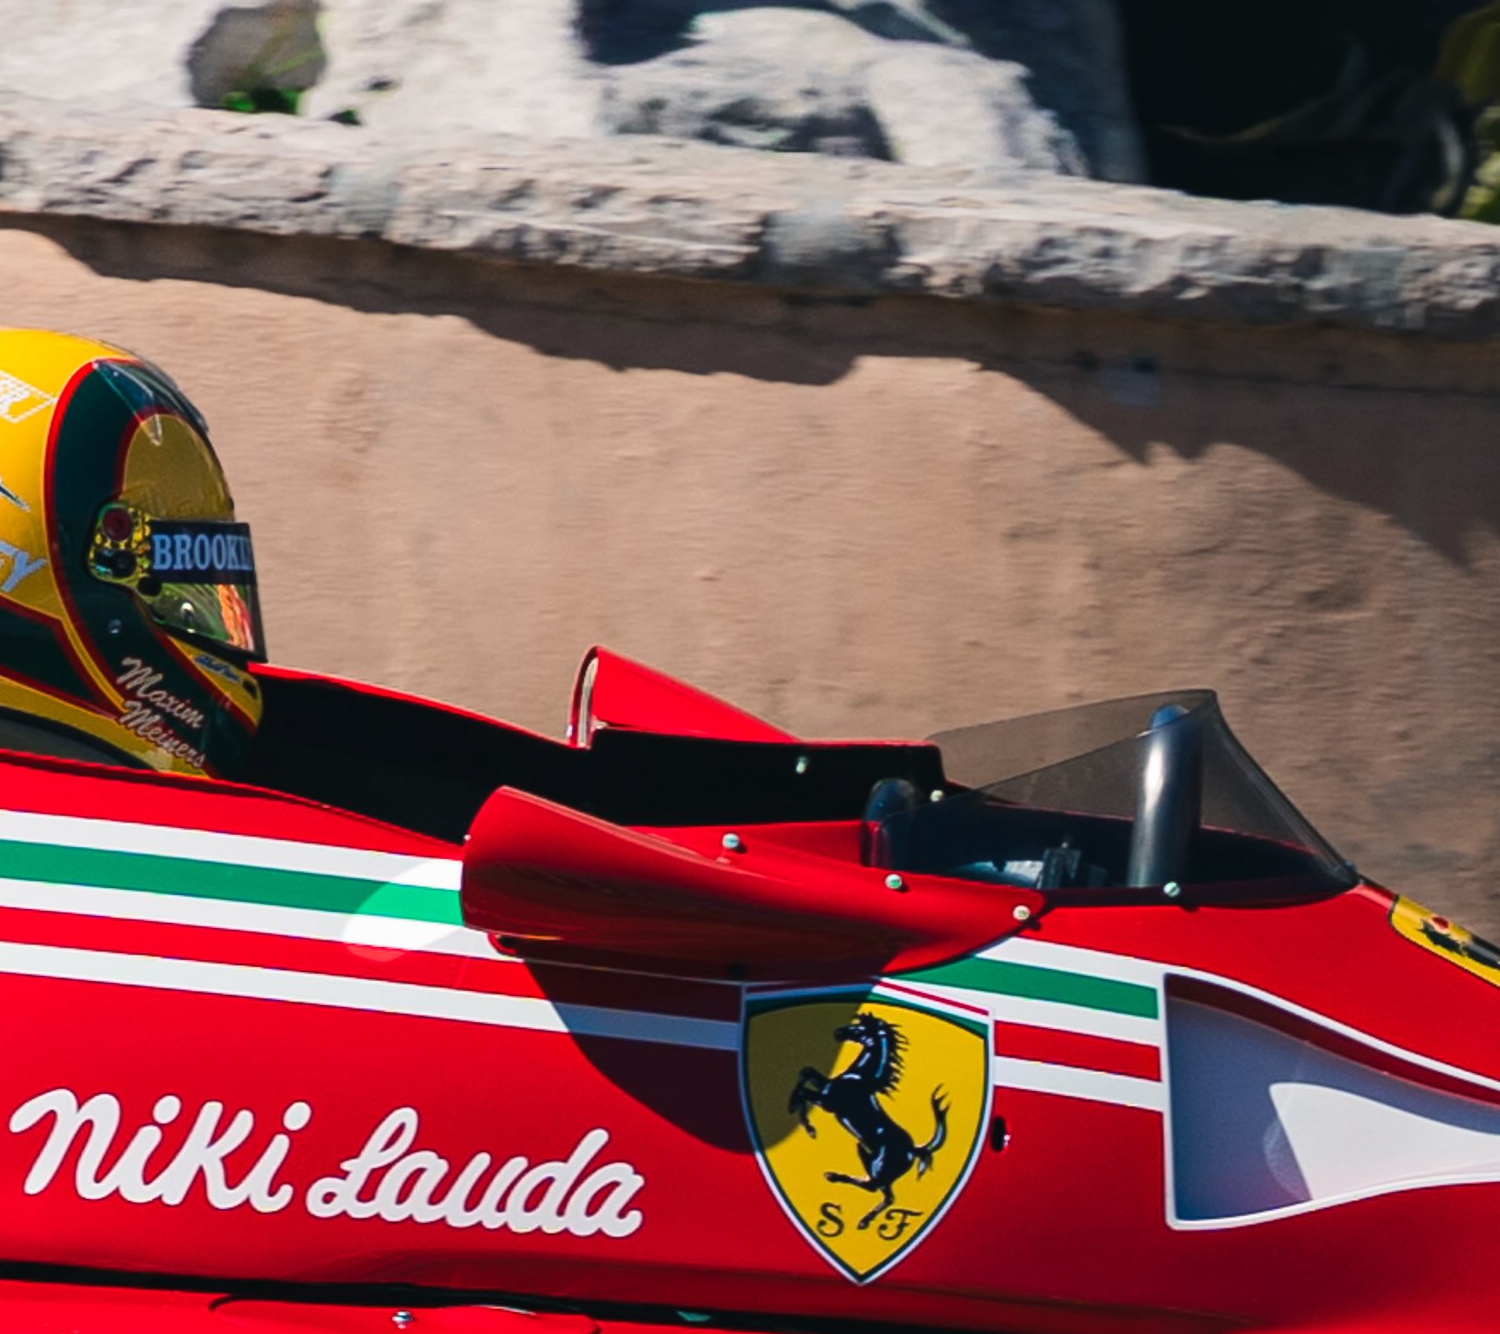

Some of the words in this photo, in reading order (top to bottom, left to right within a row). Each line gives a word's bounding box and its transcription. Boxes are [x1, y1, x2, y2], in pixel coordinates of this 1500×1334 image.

[116, 657, 204, 728] Maxim
[305, 1107, 644, 1237] Lauda
[816, 1201, 844, 1237] S
[877, 1208, 924, 1241] F
